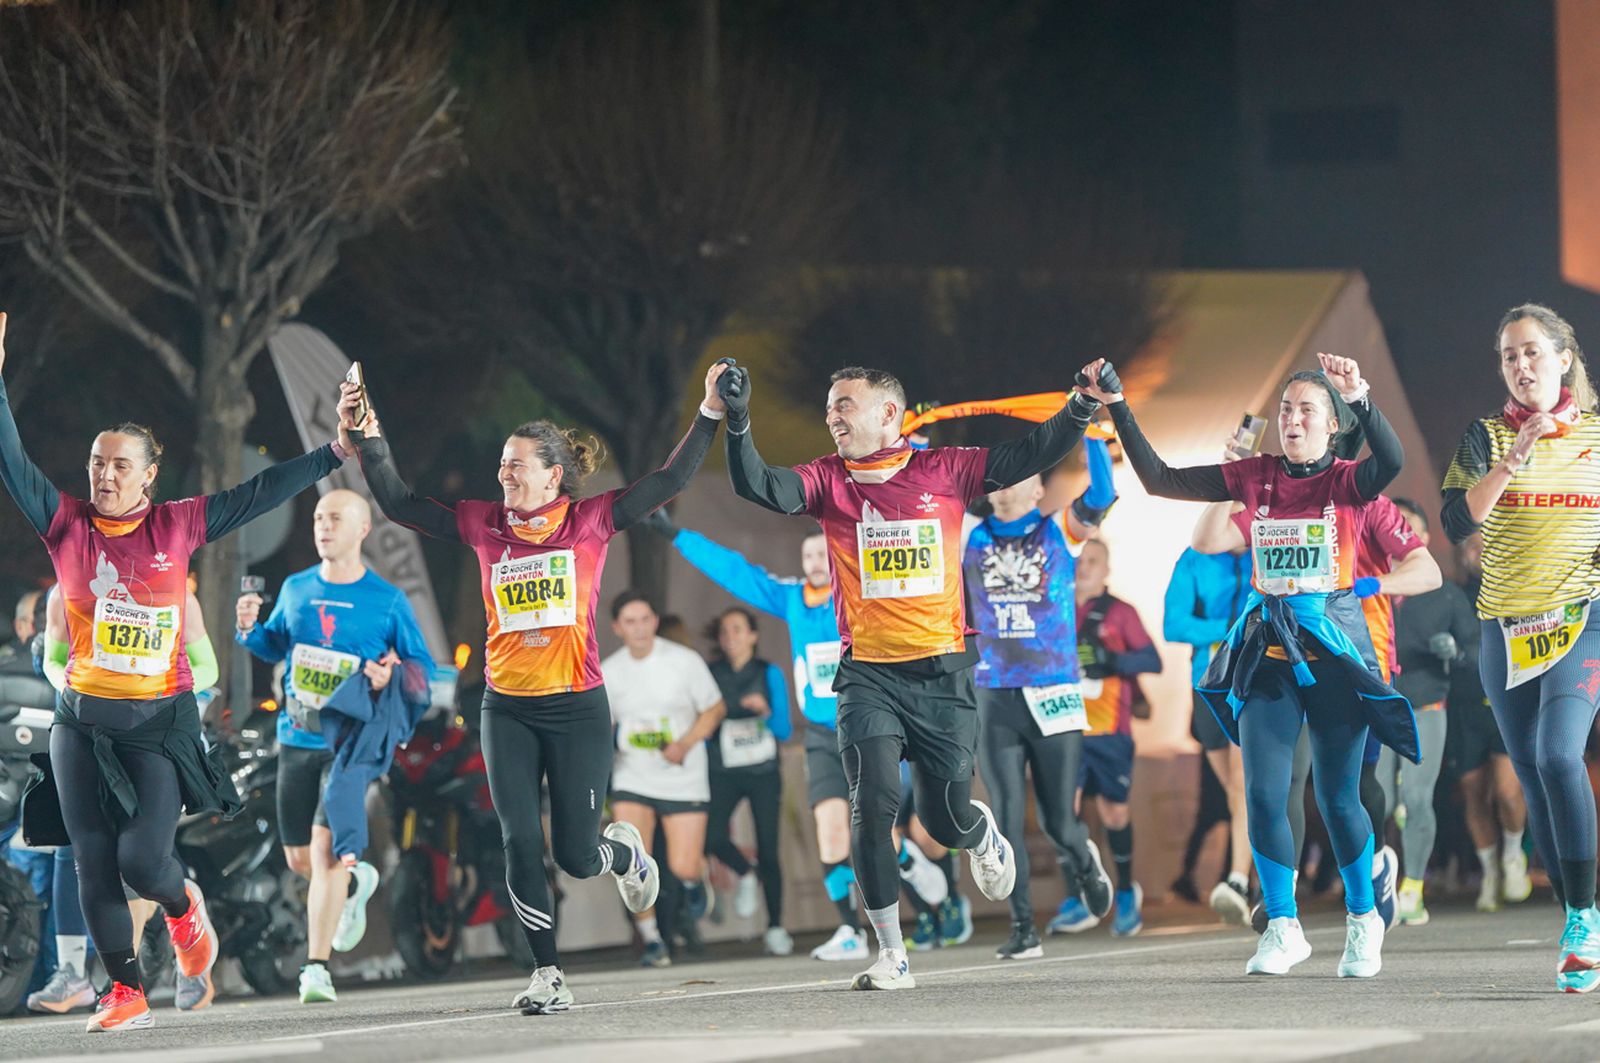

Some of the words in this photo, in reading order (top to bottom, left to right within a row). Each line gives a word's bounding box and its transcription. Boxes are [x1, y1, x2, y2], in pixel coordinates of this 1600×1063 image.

[875, 529, 900, 538] NOCHE
[901, 529, 911, 537] DE
[867, 539, 883, 549] SAN
[1259, 538, 1273, 547] SAN
[871, 547, 931, 572] 12979
[1263, 547, 1320, 570] 12207
[509, 564, 532, 574] NOCHE
[499, 575, 517, 584] SAN
[502, 578, 566, 606] 12884
[104, 614, 121, 623] SAN
[115, 608, 139, 619] NOCHE
[1519, 613, 1545, 624] NOCHE
[1513, 625, 1530, 637] SAN
[107, 624, 163, 651] 13718
[1525, 626, 1570, 659] 1075
[302, 668, 343, 692] 2439
